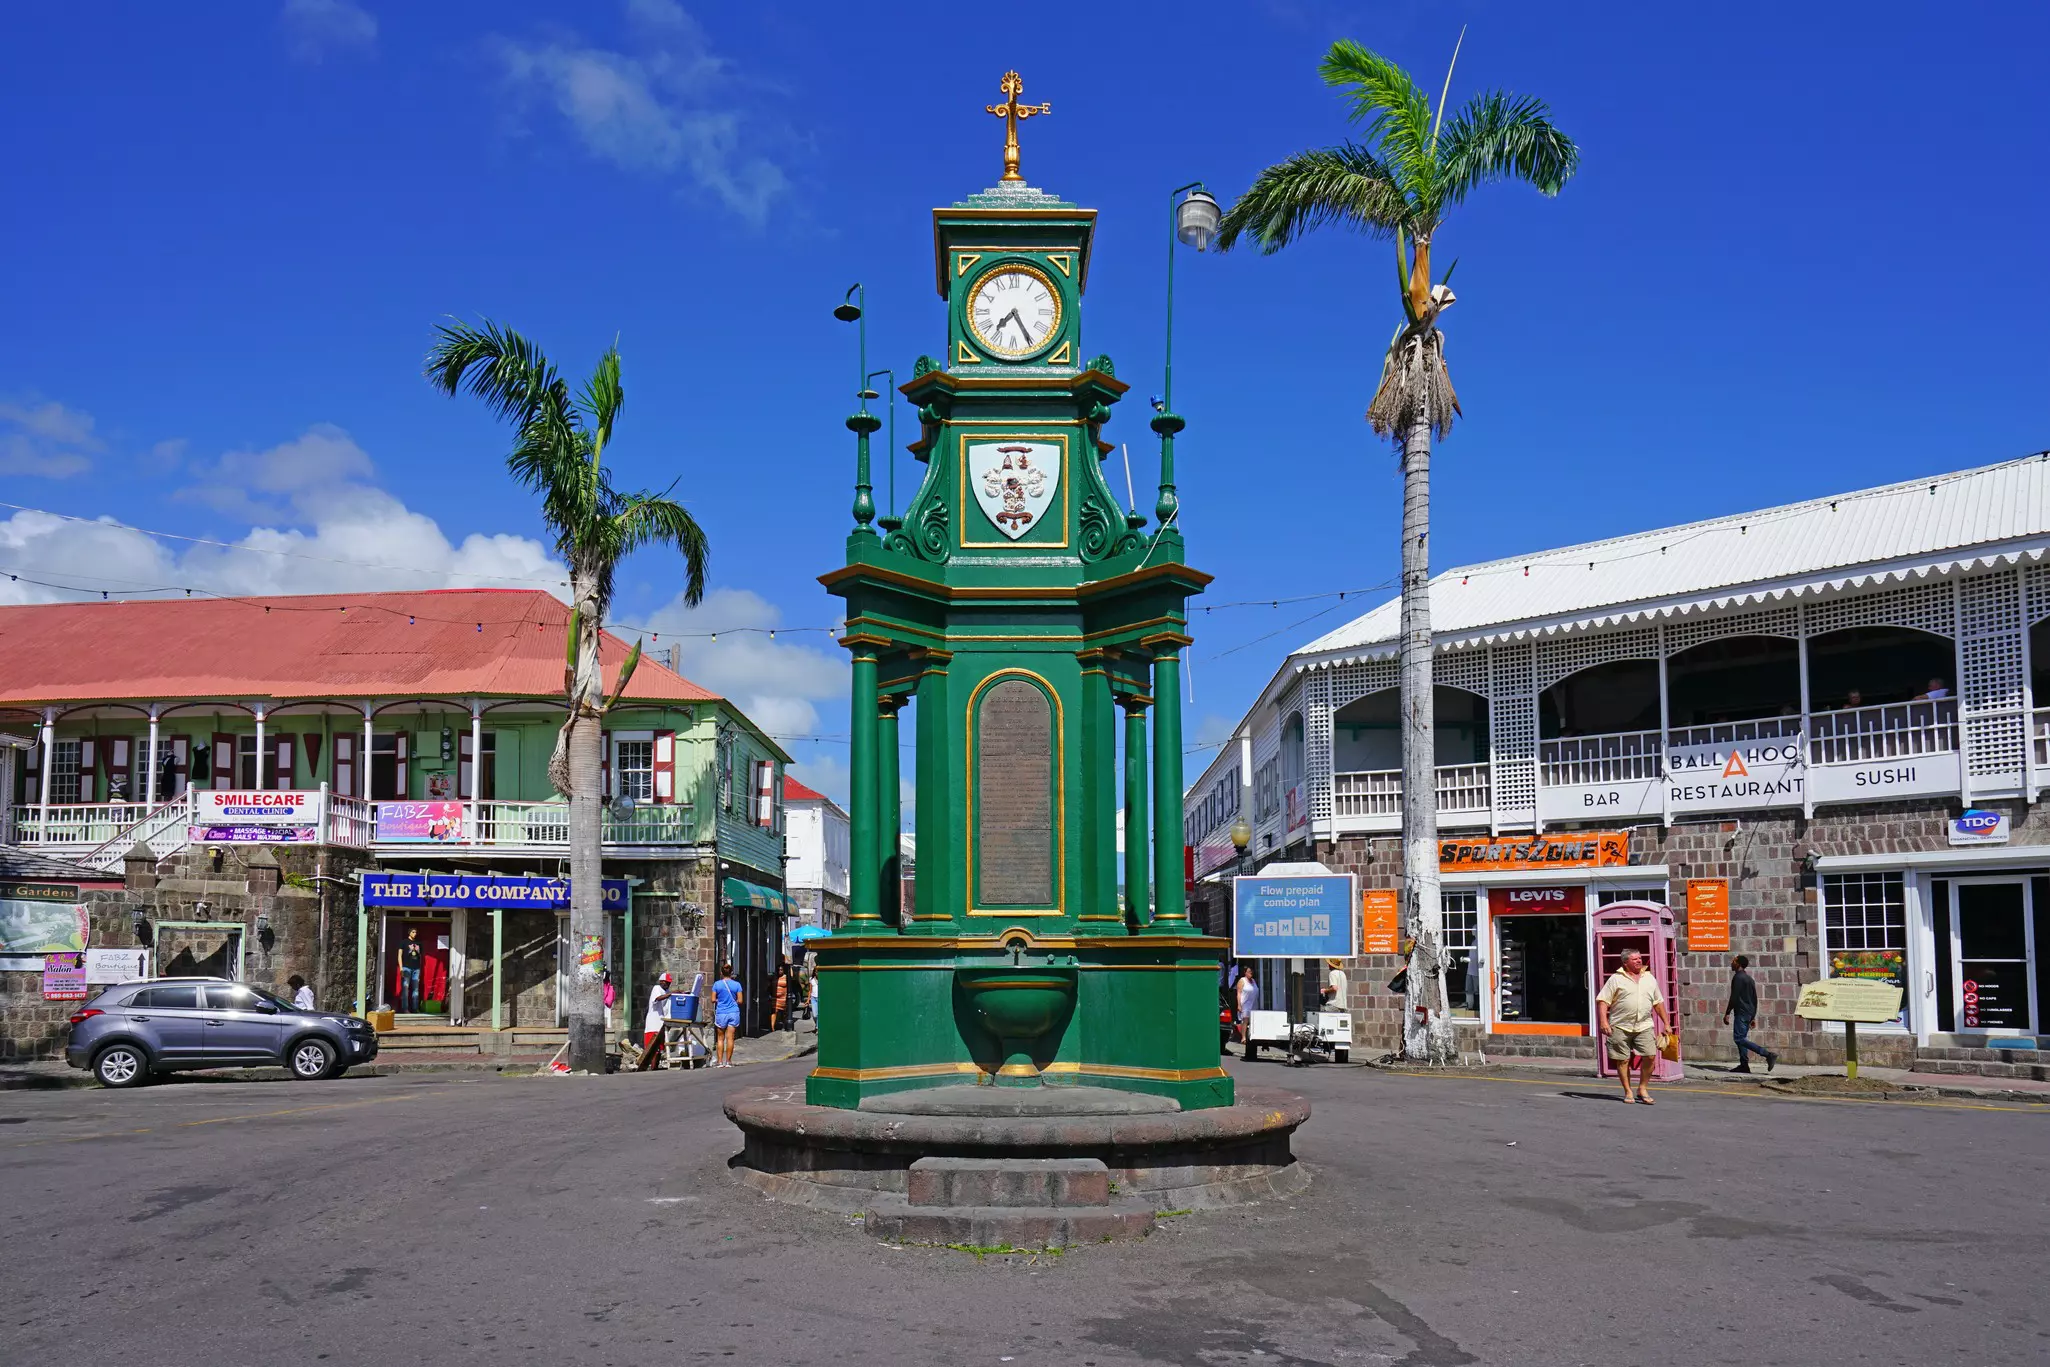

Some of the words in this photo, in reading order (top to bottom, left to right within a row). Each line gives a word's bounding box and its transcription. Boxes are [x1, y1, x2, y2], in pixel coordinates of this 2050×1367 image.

[1671, 744, 1798, 778] BALLAHOO
[1855, 767, 1916, 786] SUSHI
[1671, 777, 1804, 801] RESTAURANT
[214, 794, 305, 806] SMILECARE
[1583, 791, 1620, 807] BAR
[228, 807, 260, 815] DENTAL
[261, 807, 289, 815] CLINIC
[381, 804, 434, 820] FABZ
[1962, 816, 1997, 827] TDC
[234, 827, 267, 835] MASSAGE
[16, 886, 75, 897] Gardens
[371, 883, 412, 898] THE
[417, 884, 470, 899] POLO
[1260, 886, 1283, 895] Flow
[1285, 884, 1323, 896] prepaid
[1263, 897, 1297, 907] combo
[1299, 897, 1320, 908] plan
[1313, 920, 1327, 930] XL
